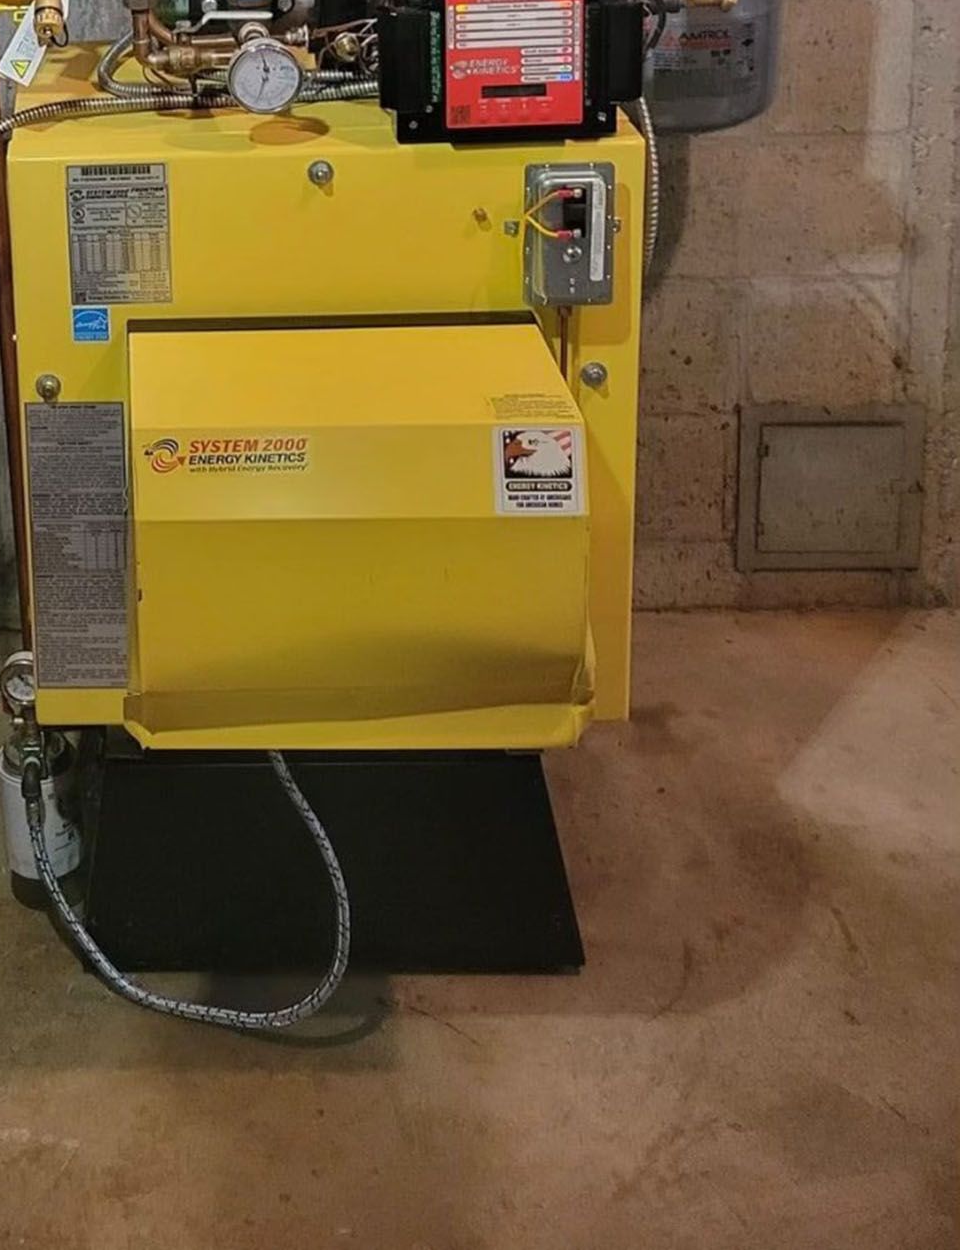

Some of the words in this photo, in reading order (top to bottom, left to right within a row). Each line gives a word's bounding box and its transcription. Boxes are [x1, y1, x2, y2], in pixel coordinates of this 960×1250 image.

[469, 58, 508, 67] ENERGY
[470, 65, 517, 75] KINETICS
[190, 439, 258, 453] SYSTEM
[262, 437, 307, 452] 2000
[189, 454, 242, 465] ENERGY
[244, 452, 305, 463] KINETICS
[208, 465, 236, 473] Hybrid
[237, 465, 266, 473] Energy
[508, 482, 535, 490] ENERGY
